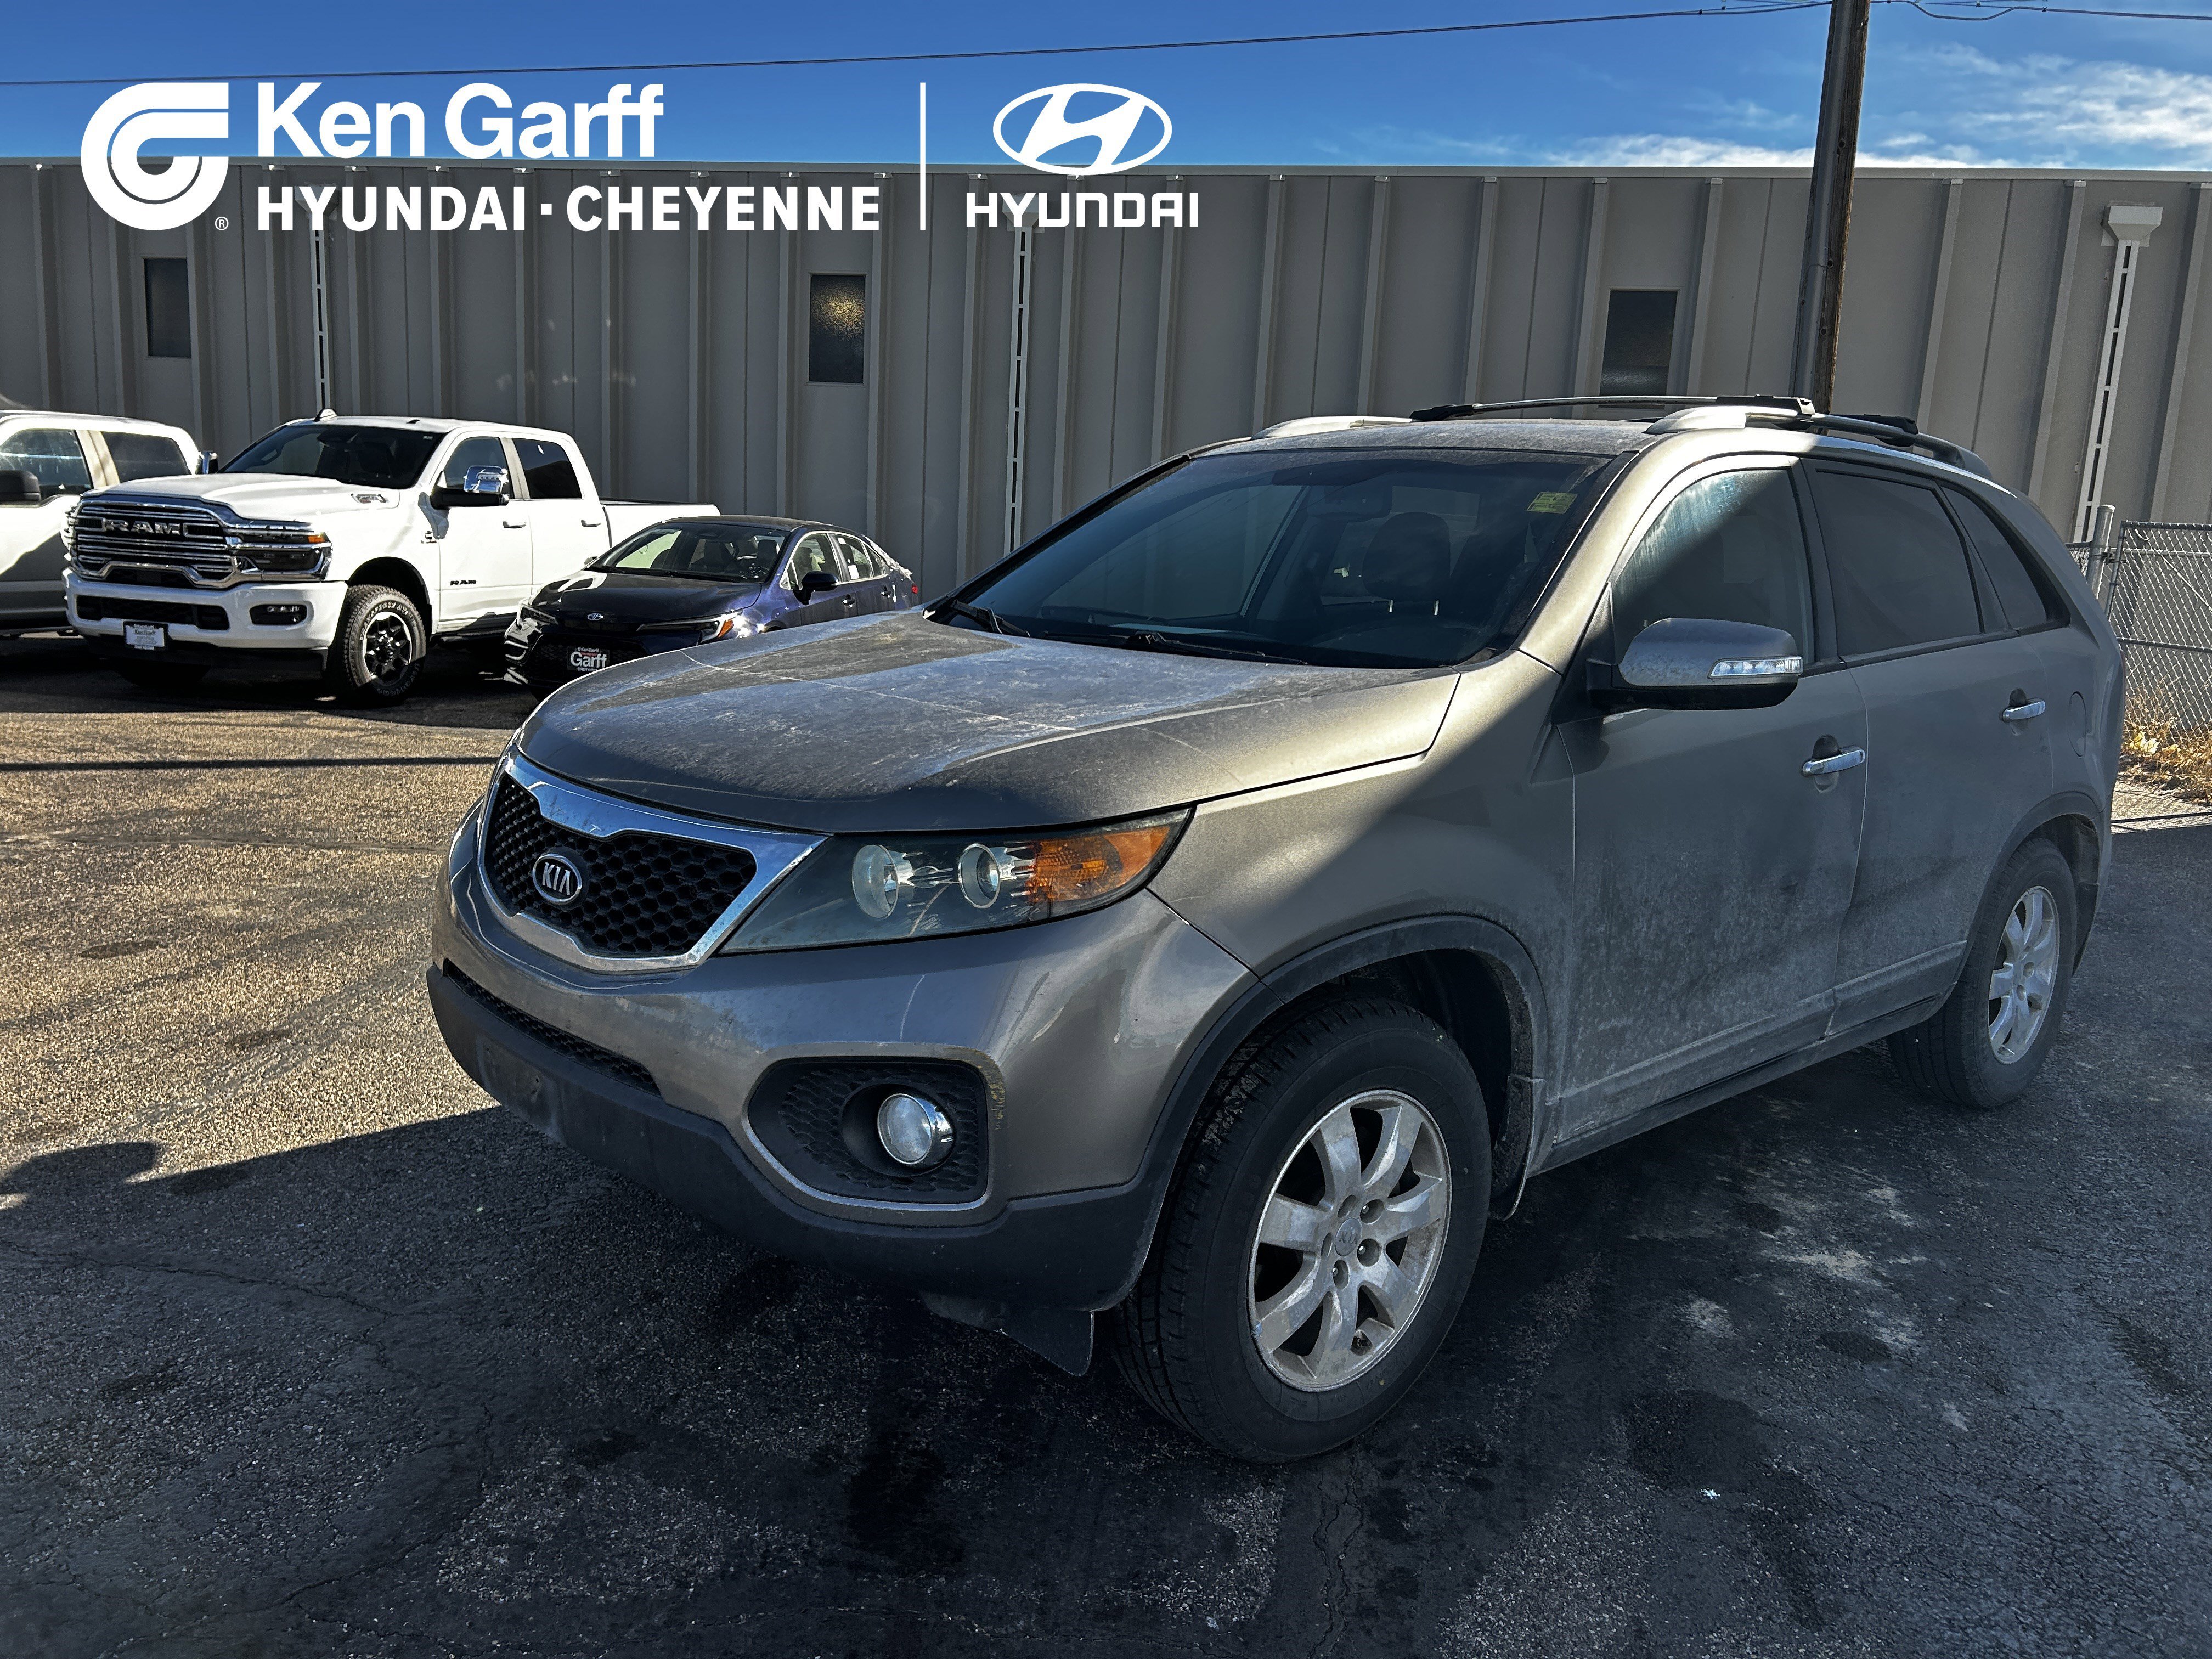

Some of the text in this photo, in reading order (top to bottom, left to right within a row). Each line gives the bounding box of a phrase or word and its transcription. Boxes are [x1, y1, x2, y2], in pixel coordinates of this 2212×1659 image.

[106, 518, 180, 535] RAM
[571, 651, 607, 668] Garff
[541, 862, 571, 896] KIA
[1339, 1231, 1359, 1245] KIA
